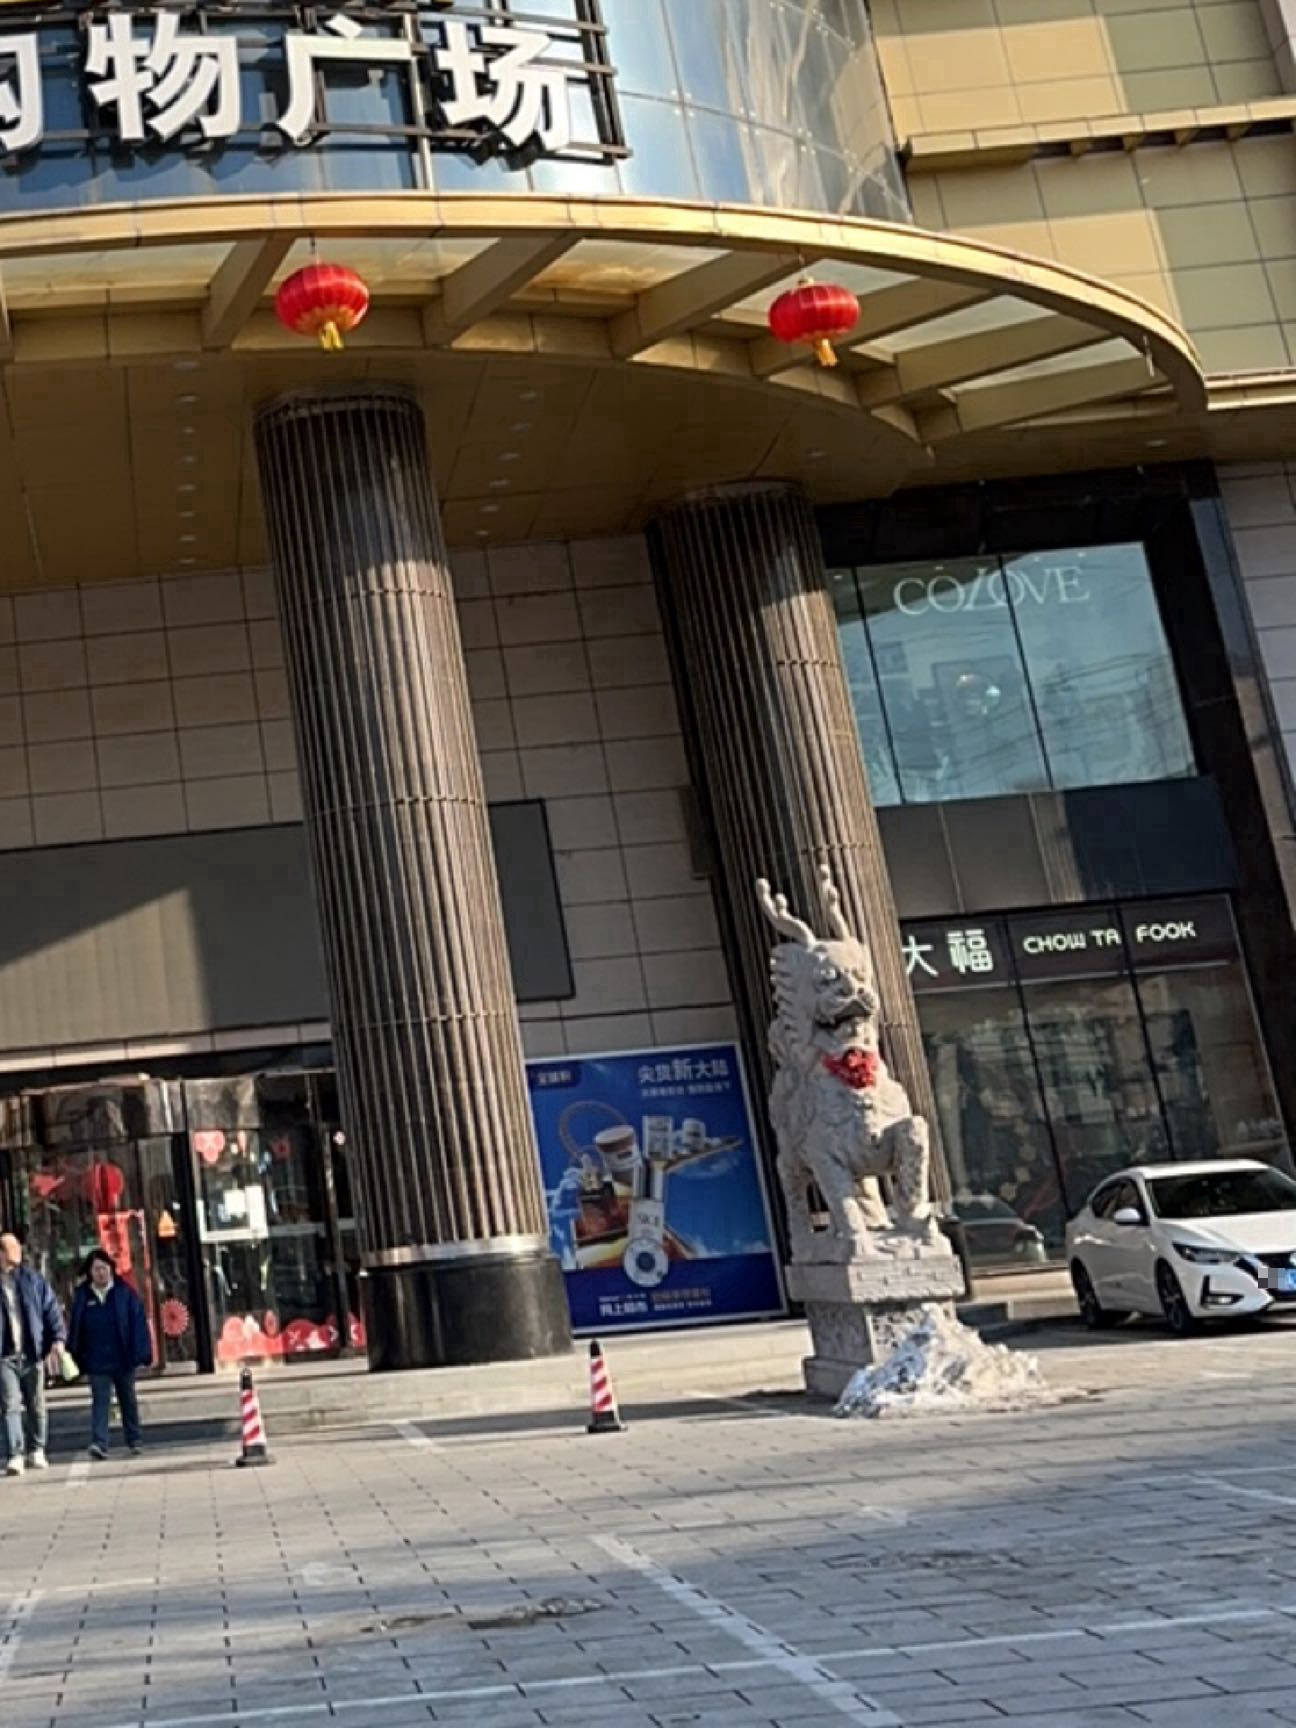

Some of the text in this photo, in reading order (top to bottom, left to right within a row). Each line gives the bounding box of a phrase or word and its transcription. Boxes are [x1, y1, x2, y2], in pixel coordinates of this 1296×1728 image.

[1023, 921, 1197, 955] CHOW TA FOOK
